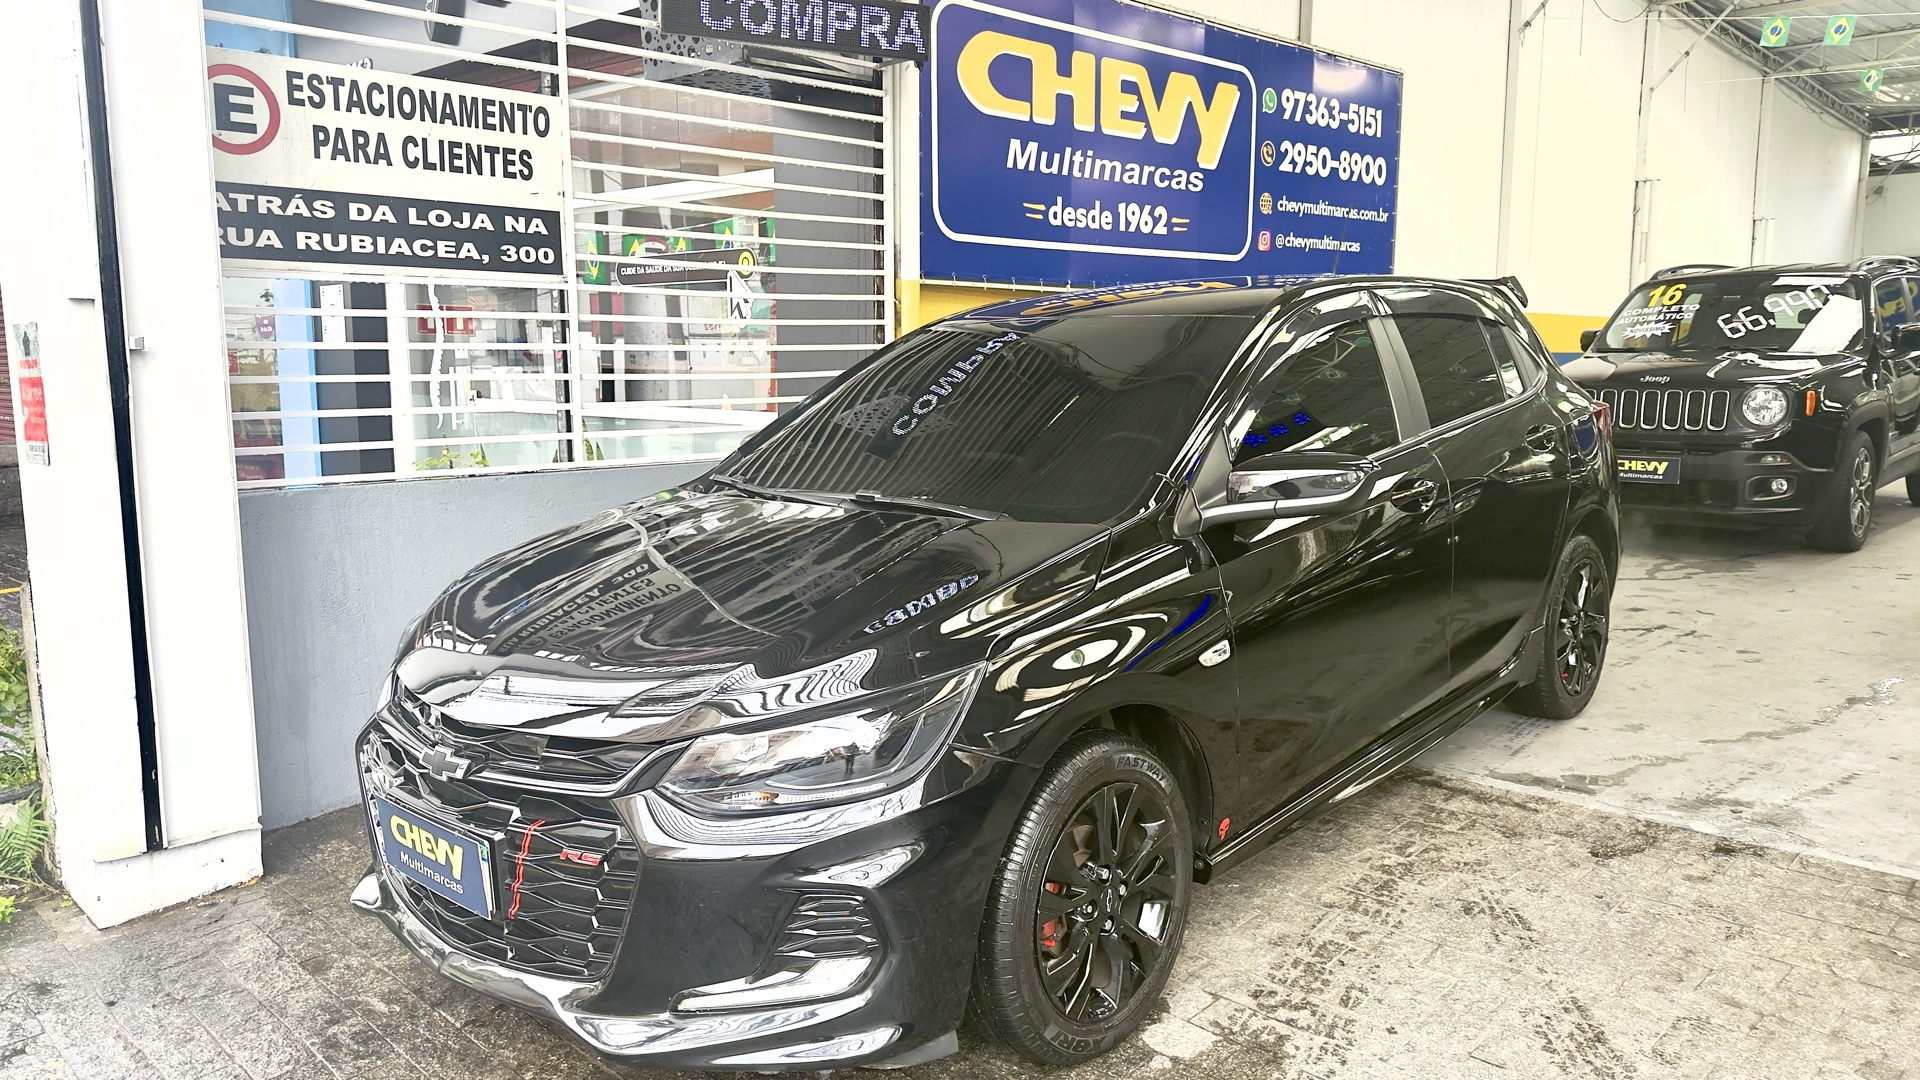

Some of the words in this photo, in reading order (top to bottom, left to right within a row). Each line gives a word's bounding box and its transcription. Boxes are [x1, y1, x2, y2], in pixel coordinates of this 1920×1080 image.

[700, 0, 926, 54] COMPRA
[213, 83, 258, 134] E
[286, 70, 550, 138] ESTACIONAMENTO
[957, 30, 1241, 170] CHEVY
[1281, 88, 1383, 138] 97363-5151
[312, 124, 393, 167] PARA
[402, 135, 534, 182] CLIENTES
[1006, 138, 1204, 192] Multimarcas
[1278, 140, 1387, 186] 2950-8900
[349, 201, 399, 225] DA
[408, 207, 495, 232] LOJA
[504, 215, 549, 236] NA
[1048, 196, 1113, 231] desde
[1118, 202, 1168, 235] 1962
[1277, 195, 1389, 222] chevymultimarcas.com.br
[296, 231, 491, 264] RUBIACEA,
[500, 244, 556, 265] 300
[1276, 232, 1361, 253] @chevymultimarcas
[1623, 304, 1701, 317] COMPLETO
[1647, 283, 1687, 308] 16
[1616, 312, 1695, 326] AUTOMÁTICO
[1639, 375, 1671, 384] Jeep
[1115, 756, 1169, 782] FASTWAY
[390, 814, 464, 881] CHEVY
[560, 847, 602, 867] RS
[400, 851, 464, 895] Multimarcas
